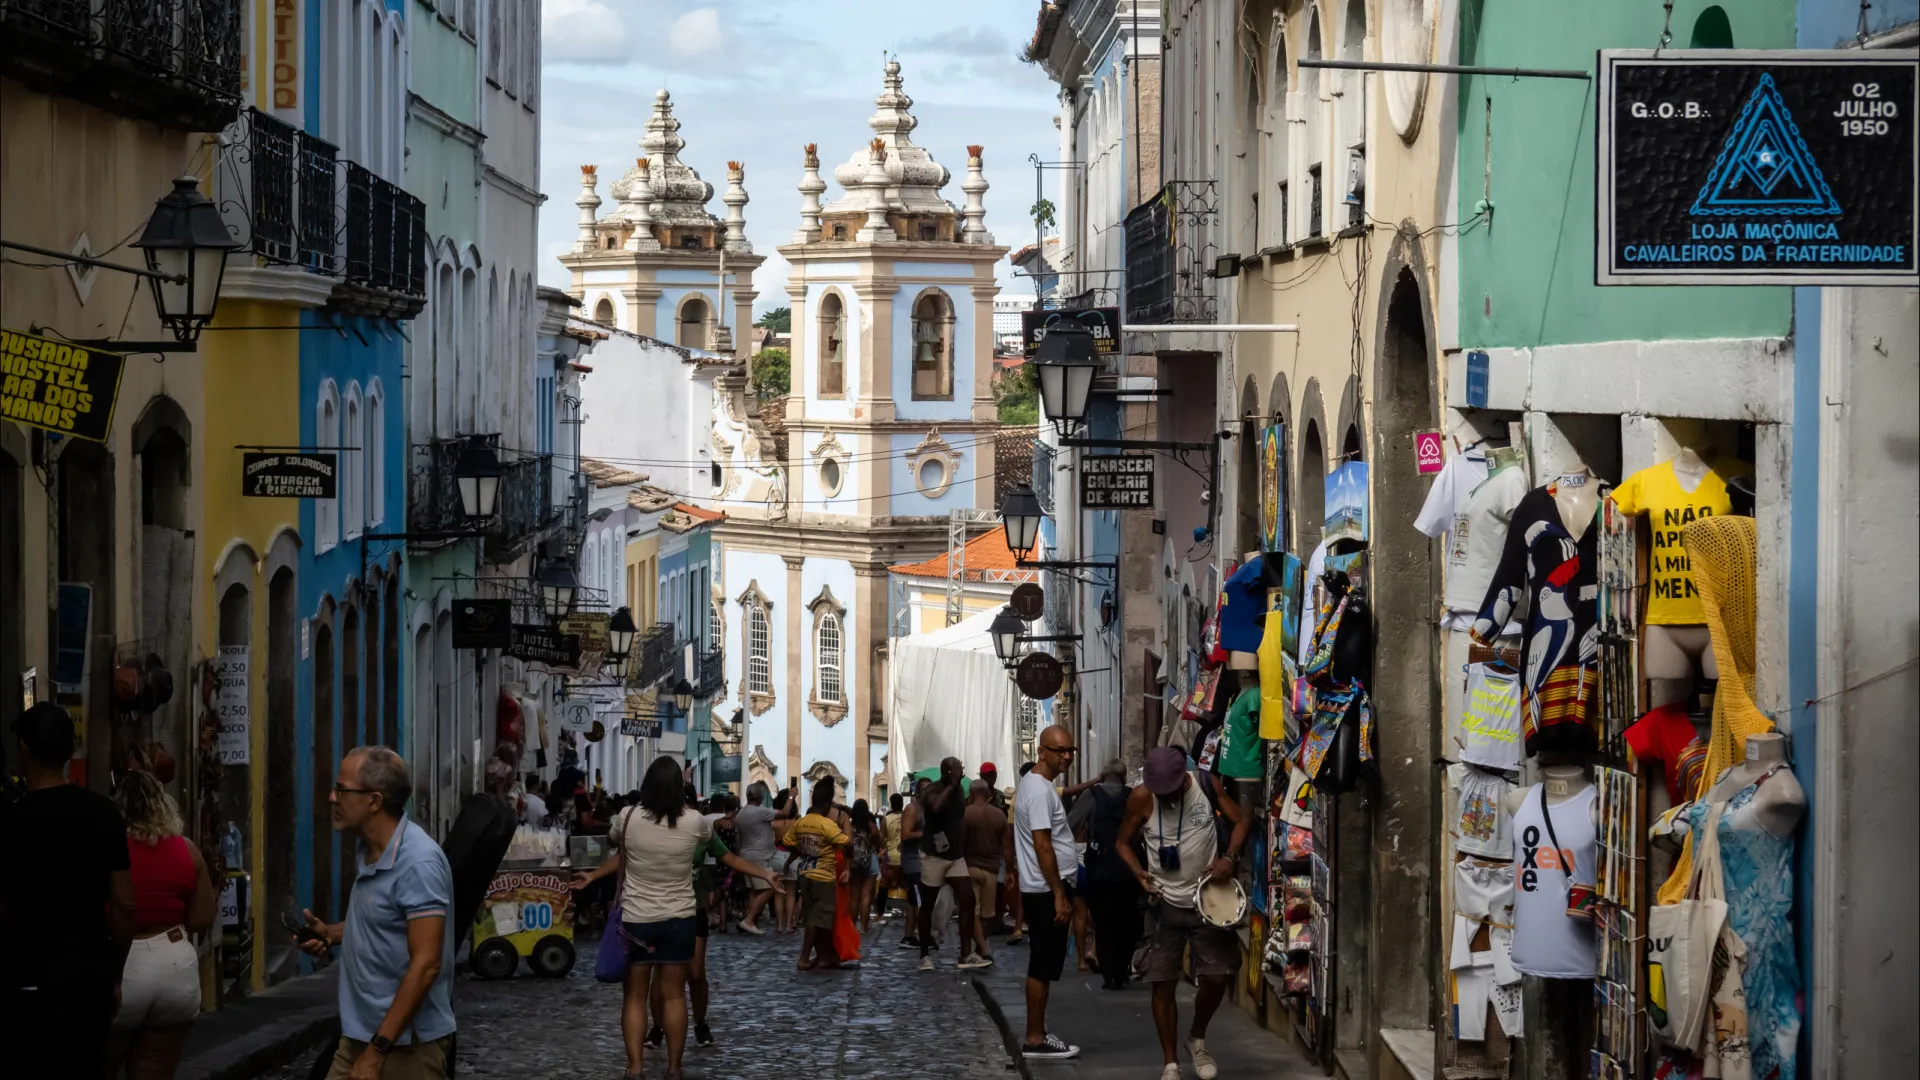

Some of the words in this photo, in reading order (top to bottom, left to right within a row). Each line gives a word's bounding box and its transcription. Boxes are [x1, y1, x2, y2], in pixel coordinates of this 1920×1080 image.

[1853, 84, 1880, 97] 02
[1833, 101, 1897, 118] JULHO
[1841, 120, 1889, 136] 1950
[1692, 223, 1738, 240] LOJA
[1745, 220, 1839, 243] MAÇÔNICA
[1623, 245, 1735, 262] CAVALEIROS
[1742, 245, 1767, 262] DA
[1776, 245, 1905, 262] FRATERNIDADE
[44, 383, 93, 413] DOS
[285, 456, 332, 476] COLORIDOS
[1082, 458, 1153, 473] RENASCER
[1420, 457, 1440, 465] airbnb
[257, 475, 320, 486] TATUAGEM
[1087, 474, 1148, 488] GALERIA
[266, 485, 323, 496] PIERCING
[1086, 490, 1105, 504] DE
[1110, 490, 1149, 504] ARTE
[523, 633, 556, 648] HOTEL
[220, 662, 246, 674] 2,50
[220, 679, 246, 688] GUA
[220, 705, 247, 718] 2,50
[222, 724, 246, 734] OCO
[222, 750, 246, 762] 7,00
[488, 873, 520, 894] ueijo
[521, 872, 569, 894] Coalho
